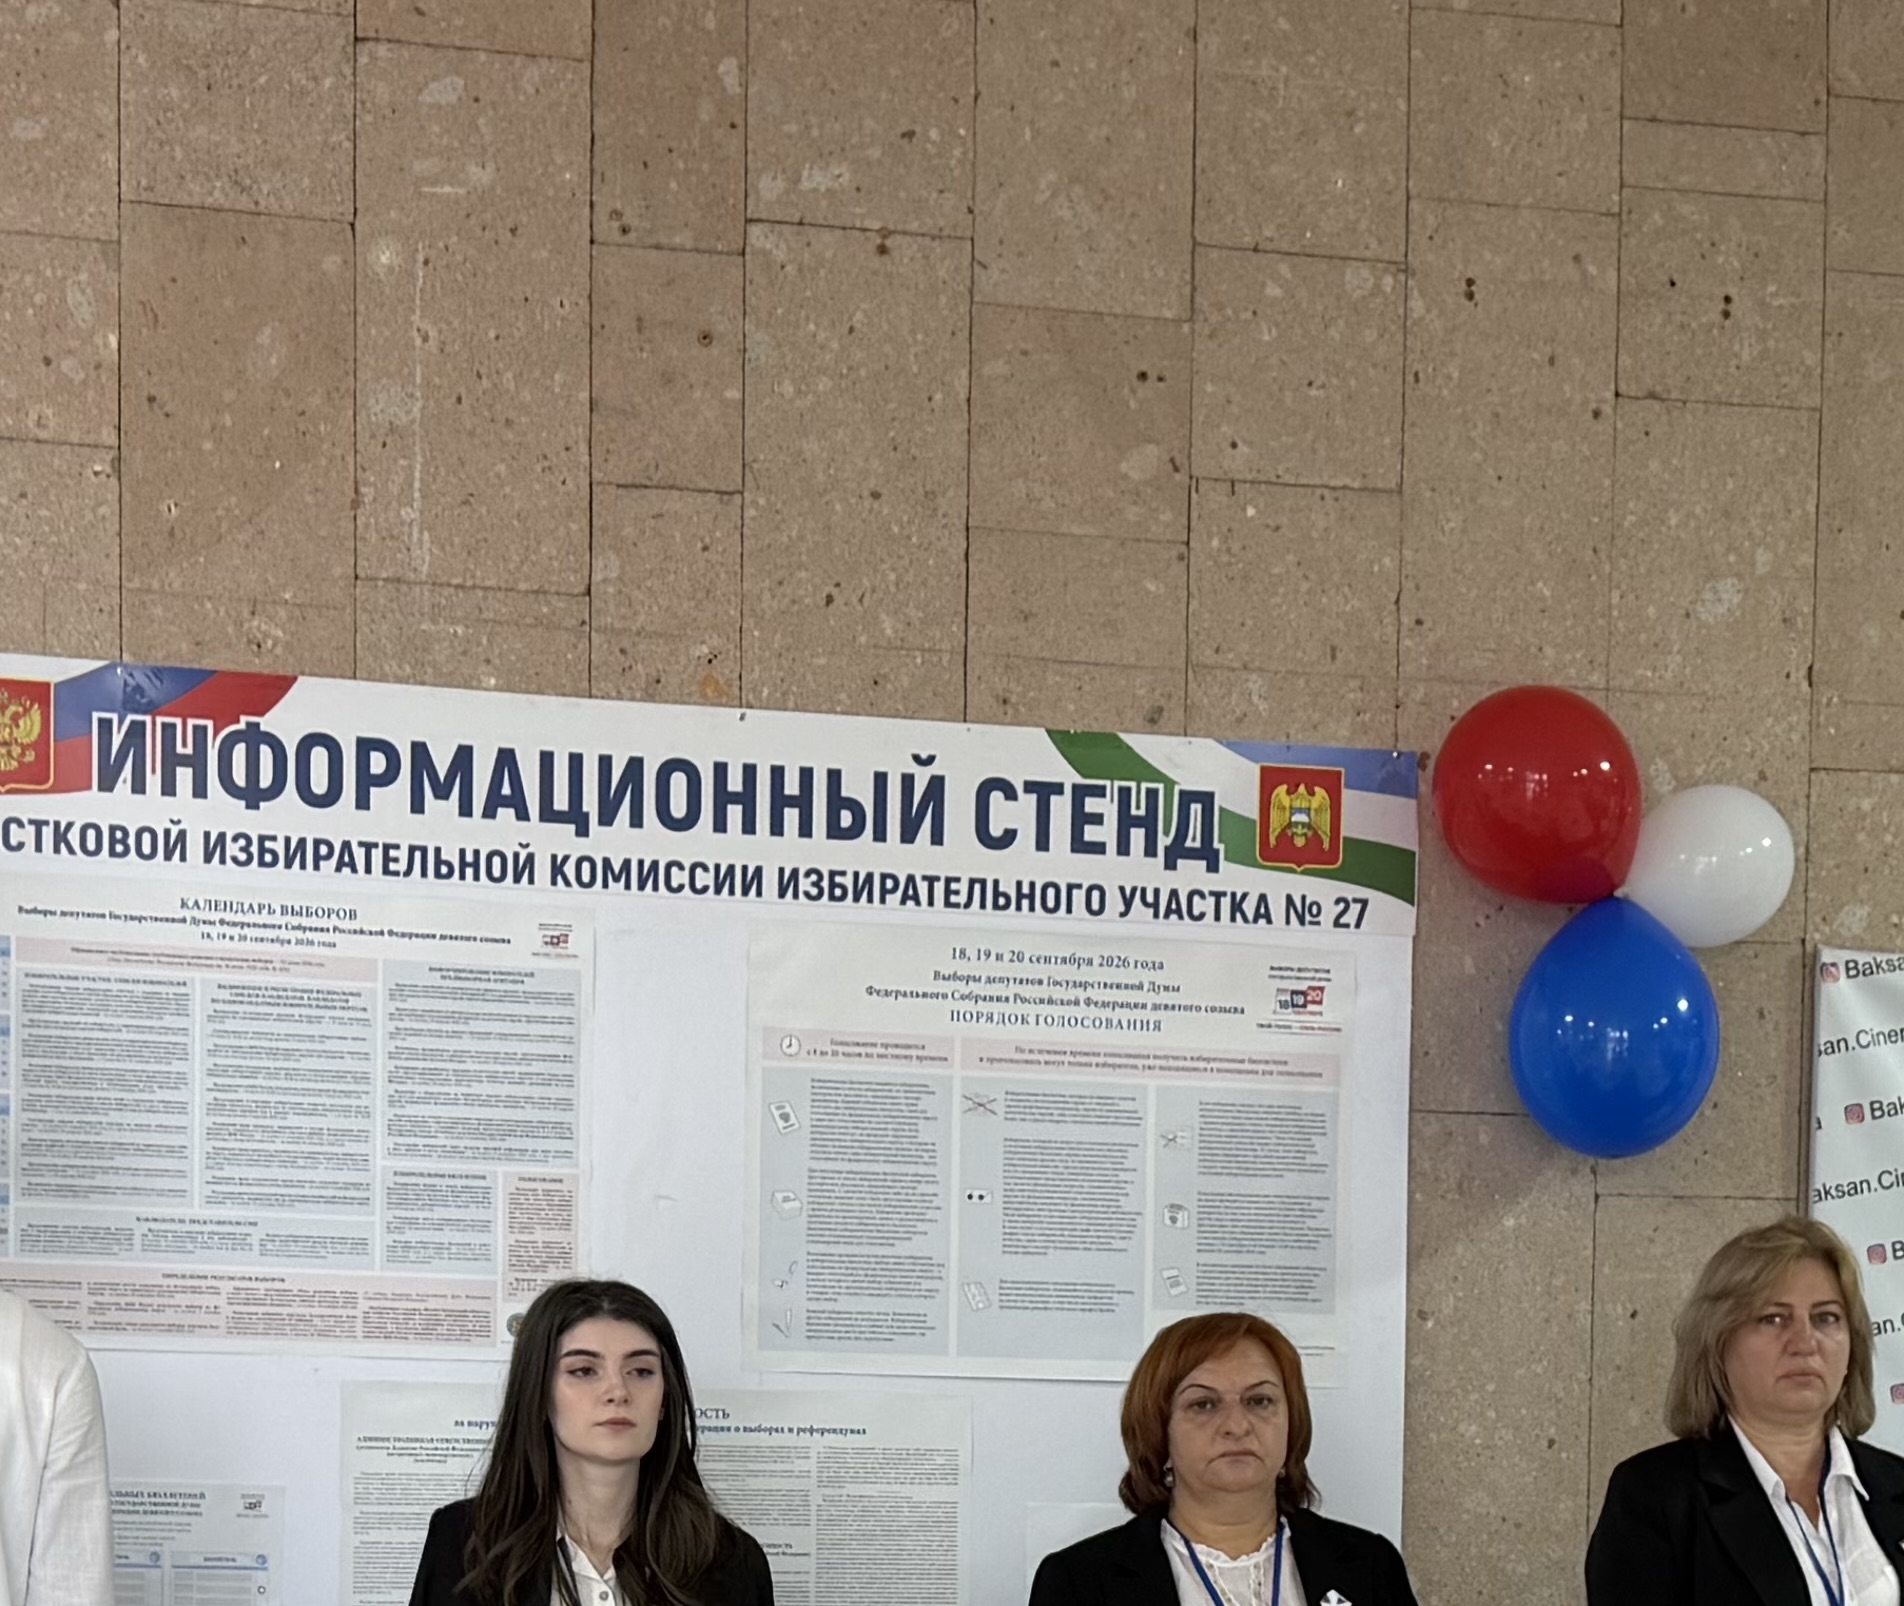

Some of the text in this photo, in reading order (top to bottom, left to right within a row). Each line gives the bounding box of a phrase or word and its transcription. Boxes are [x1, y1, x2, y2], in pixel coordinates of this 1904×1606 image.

[96, 718, 1221, 874] ИНФОРМАЦИОННЫЙ СТЕНД
[202, 831, 536, 886] ИЗБИРАТЕЛЬНОЙ
[550, 854, 764, 899] КОМИССИИ
[777, 866, 1107, 917] ИЗБИРАТЕЛЬНОГО
[1118, 886, 1273, 926] УЧАСТКА
[1285, 895, 1322, 926] №
[1333, 898, 1370, 929] 27
[180, 897, 358, 921] КАЛЕНДАРЬ ВЫБОРОВ
[951, 947, 1165, 971] 18, 19 и 20 сентября 2026 года
[933, 970, 982, 986] Выборы
[1047, 977, 1144, 993] Государственной
[1013, 993, 1081, 1007] Российской
[950, 1009, 1162, 1032] ПОРЯДОК ГОЛОСОВАНИЯ
[695, 1408, 730, 1420] ОСТЬ
